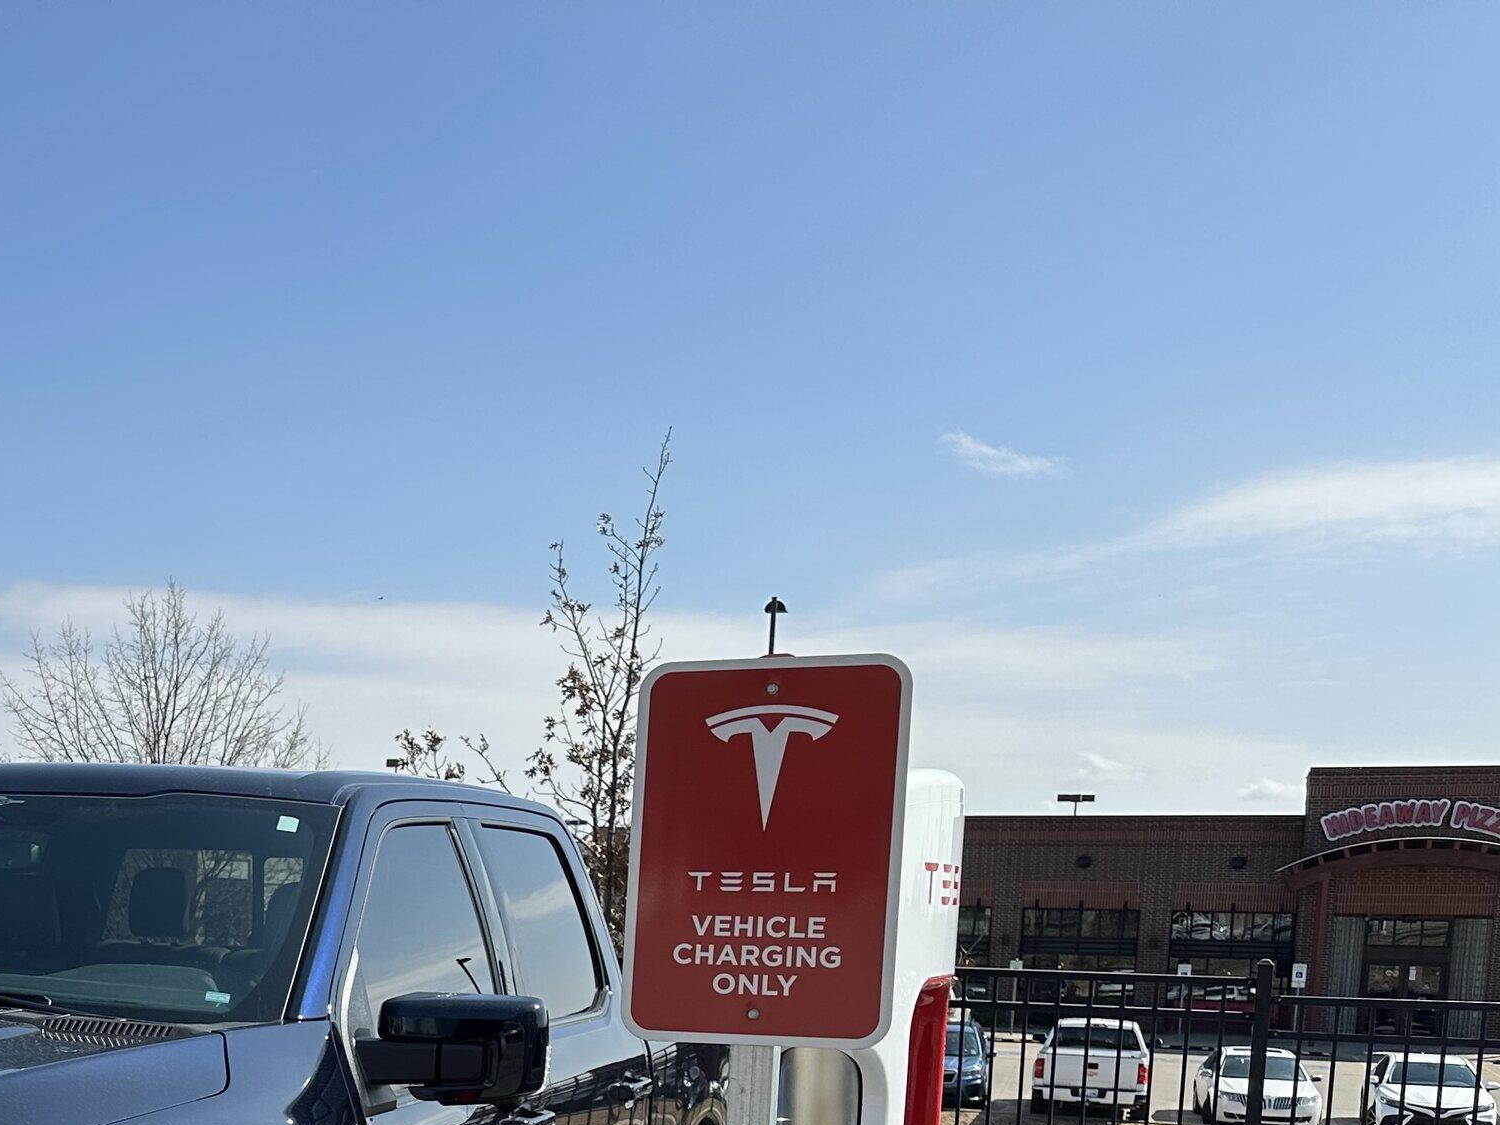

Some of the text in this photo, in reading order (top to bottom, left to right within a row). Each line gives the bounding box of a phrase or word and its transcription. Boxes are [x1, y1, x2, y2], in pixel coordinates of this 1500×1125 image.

[1322, 800, 1450, 840] HIDEAWAY
[687, 871, 838, 893] TESLA
[691, 914, 827, 939] VEHICLE
[672, 942, 842, 969] CHARGING
[712, 972, 798, 997] ONLY
